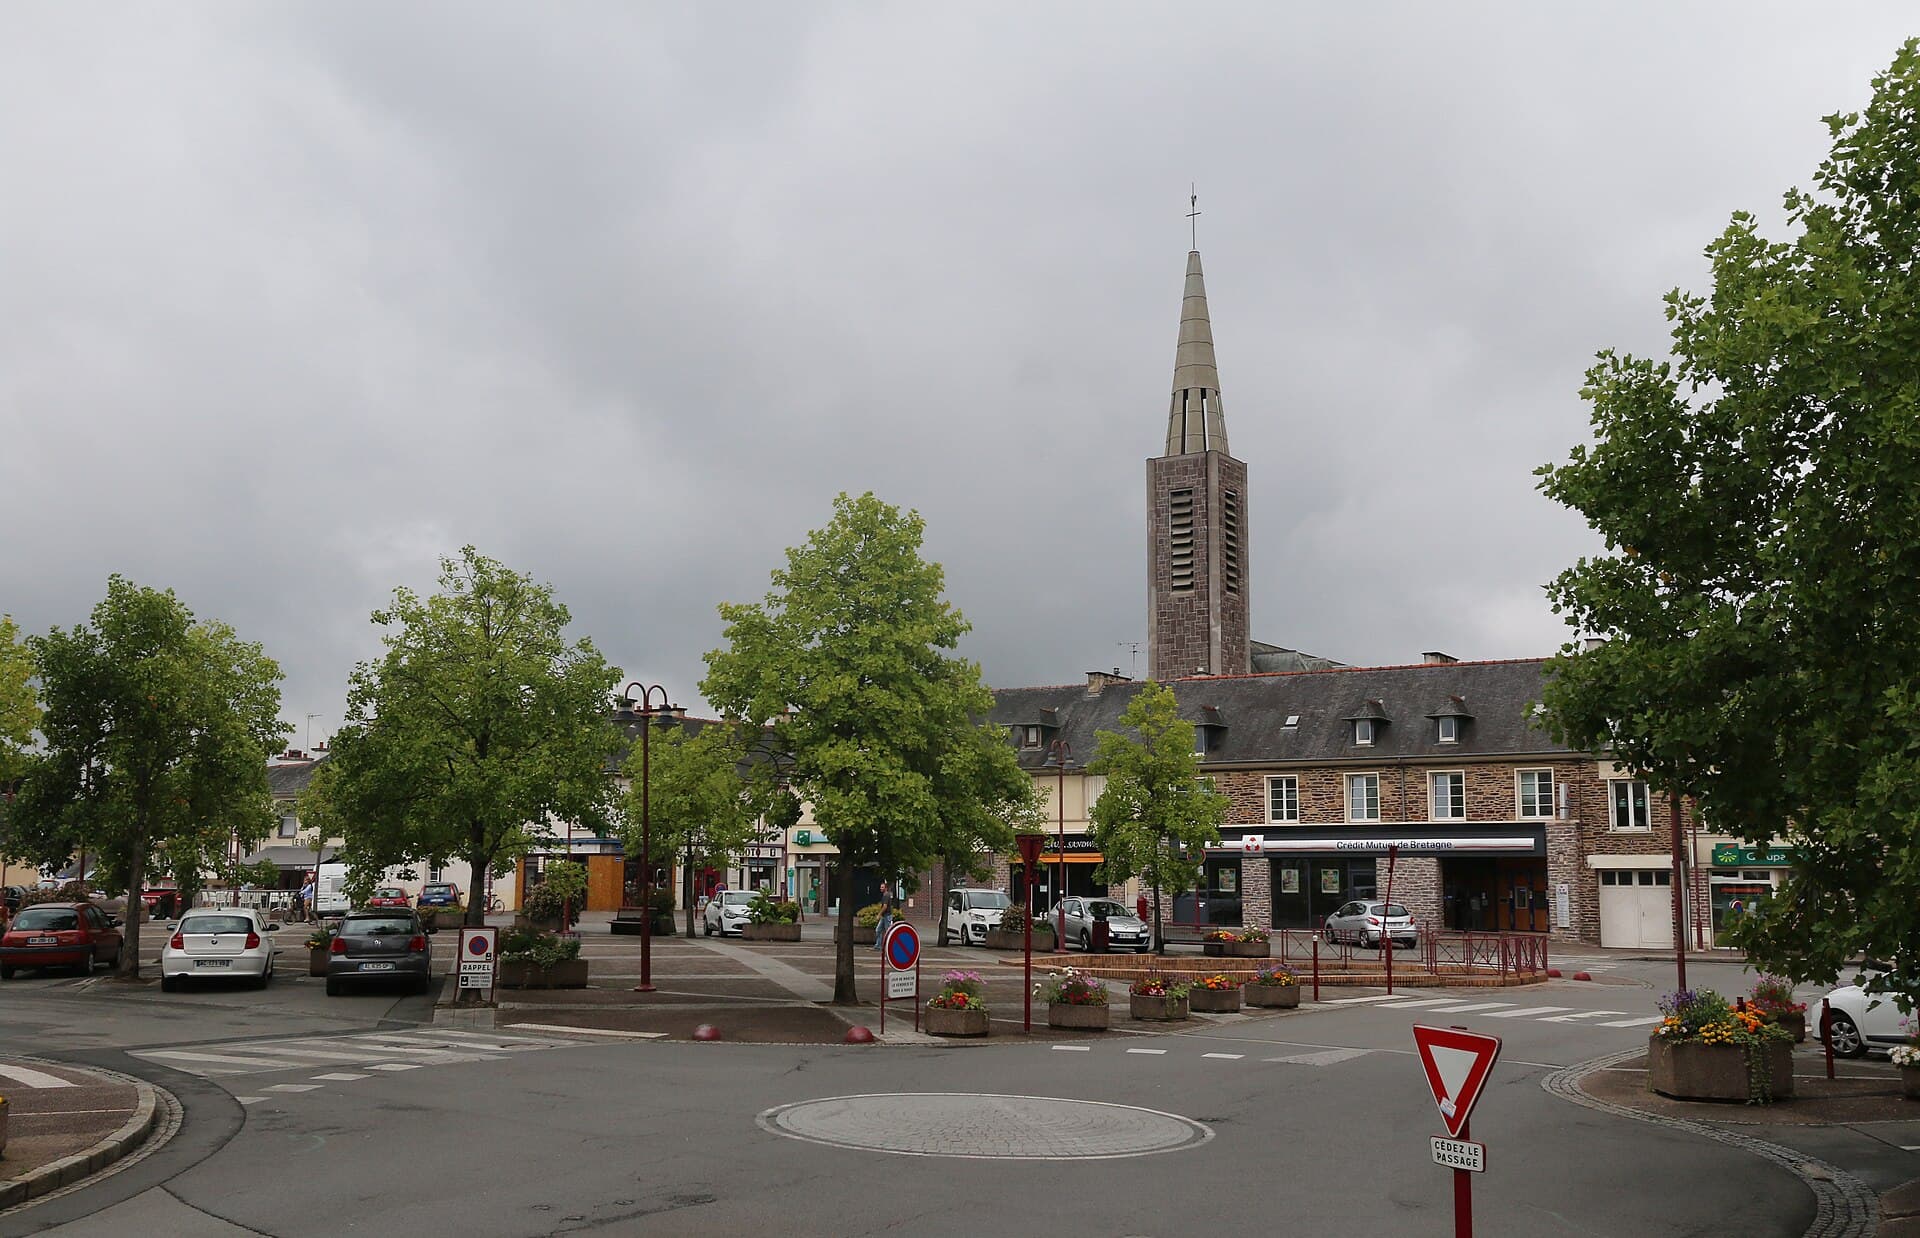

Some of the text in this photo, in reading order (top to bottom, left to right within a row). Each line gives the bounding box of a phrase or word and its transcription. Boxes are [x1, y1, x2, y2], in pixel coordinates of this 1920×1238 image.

[1336, 841, 1364, 849] Crédit
[1397, 841, 1409, 849] de
[1410, 841, 1452, 850] Bretagne
[1434, 1140, 1479, 1156] CÉDEZ LE
[1436, 1152, 1478, 1168] PASSAGE
